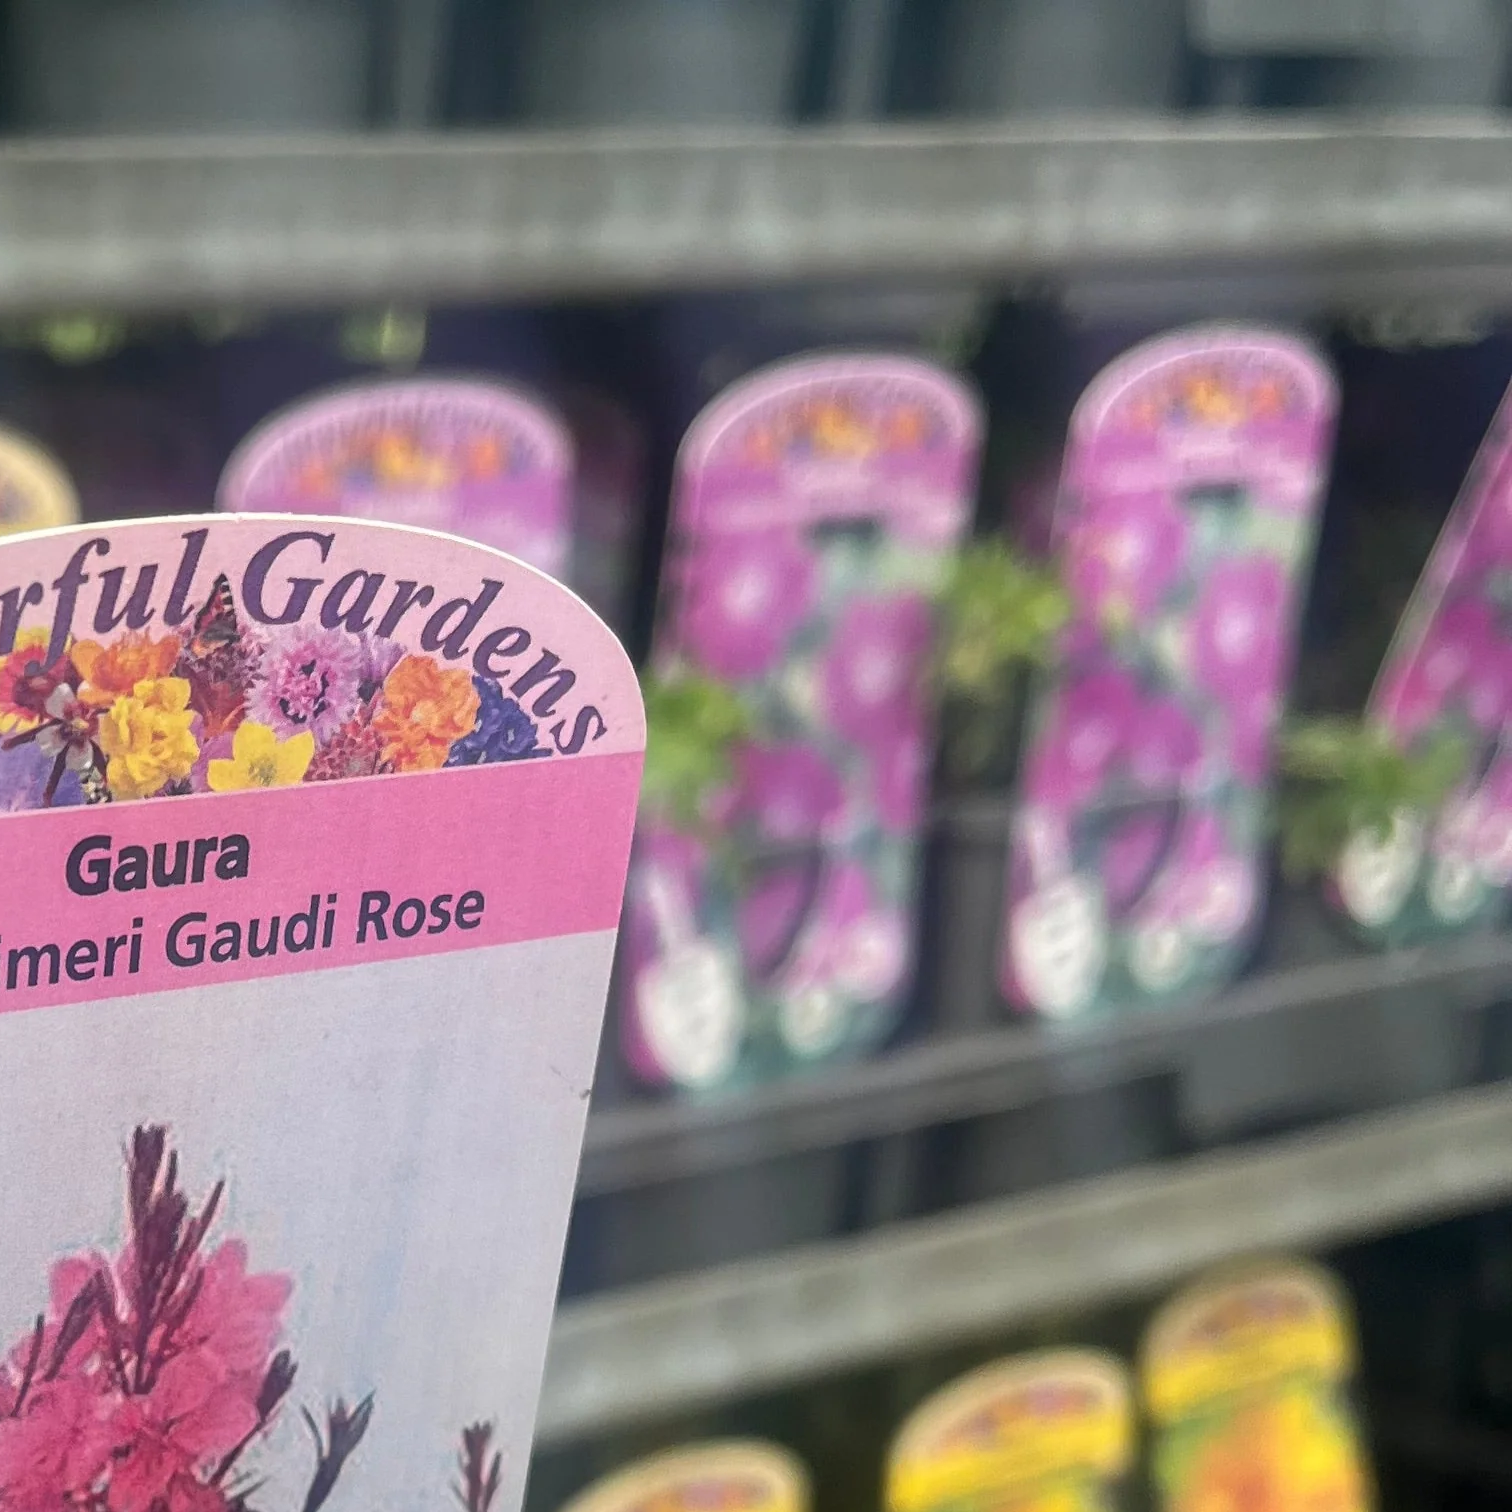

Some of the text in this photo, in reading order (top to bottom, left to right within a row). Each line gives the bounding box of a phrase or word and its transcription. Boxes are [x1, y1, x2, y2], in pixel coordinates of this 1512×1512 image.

[241, 531, 608, 756] Gardens
[65, 832, 250, 896] Gaura
[165, 893, 337, 968] Gaudi
[356, 889, 486, 944] Rose
